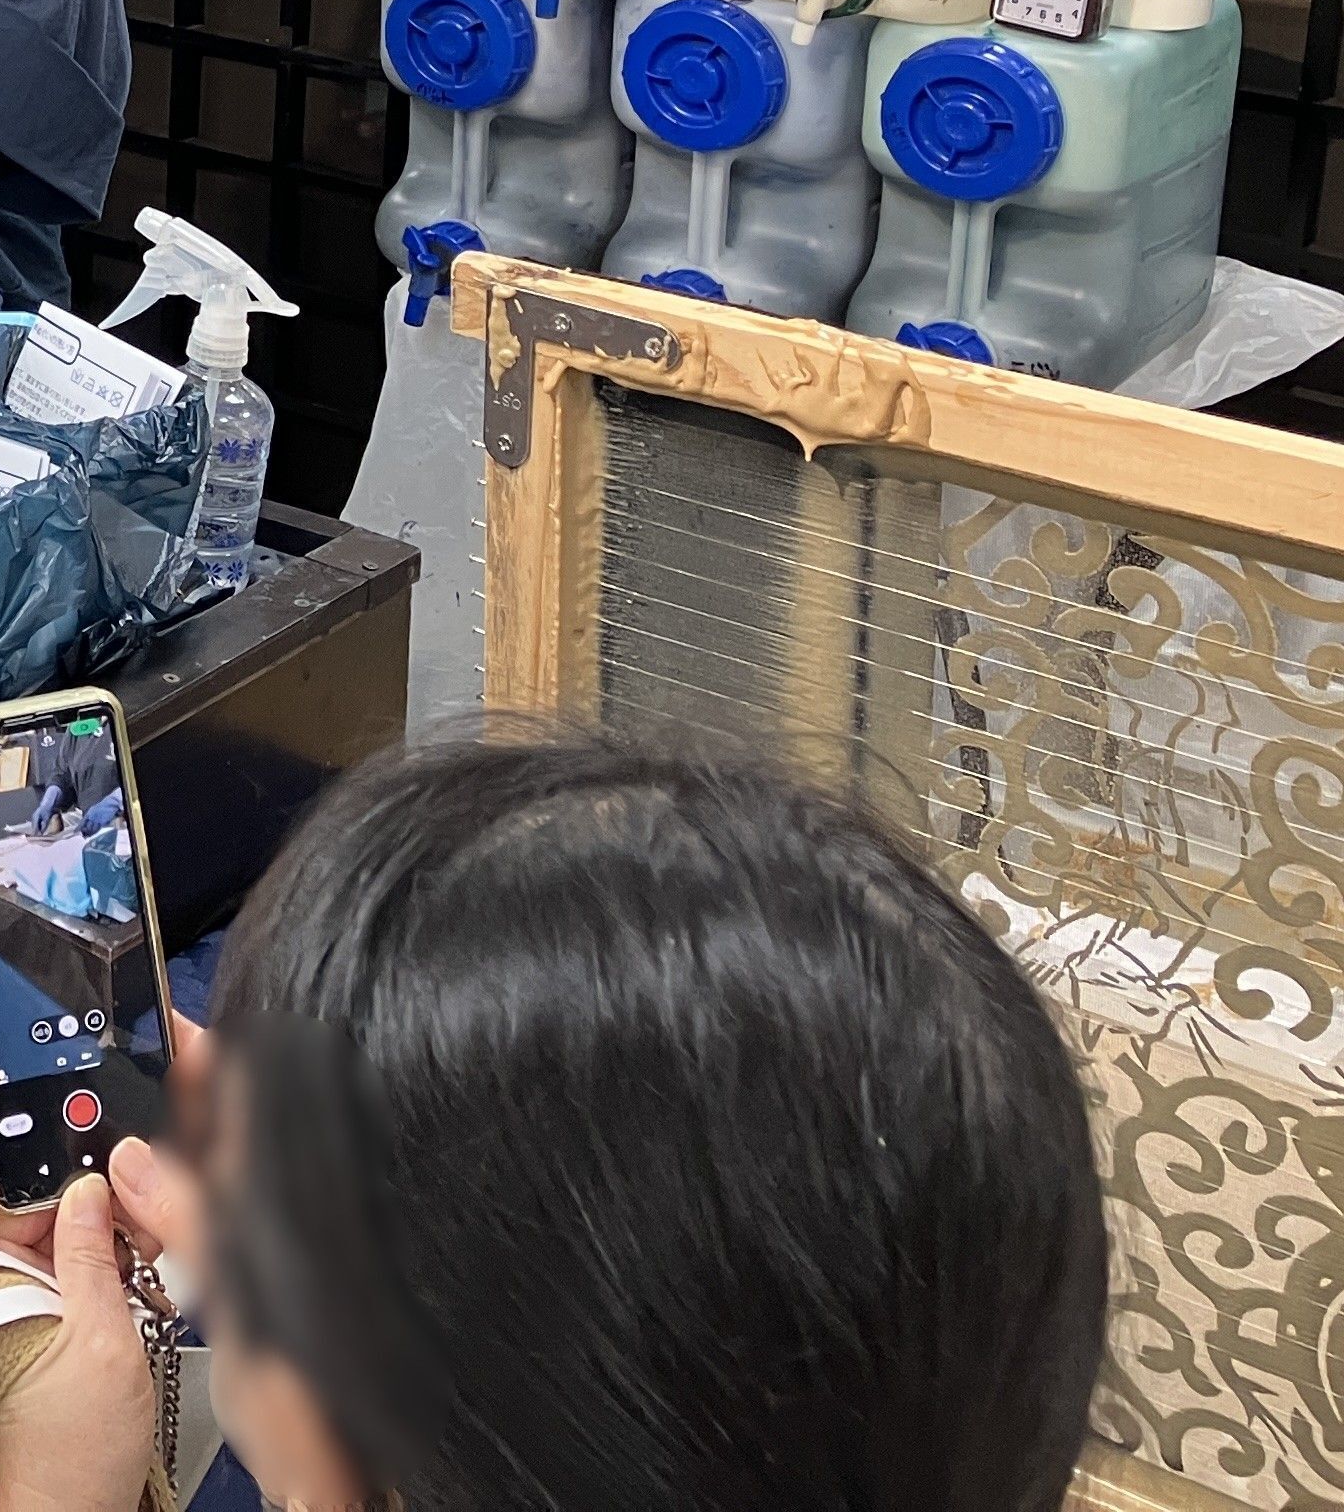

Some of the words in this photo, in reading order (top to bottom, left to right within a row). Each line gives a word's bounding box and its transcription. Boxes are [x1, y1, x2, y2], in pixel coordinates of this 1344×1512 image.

[1025, 7, 1032, 16] 7
[1039, 10, 1047, 20] 6
[1072, 9, 1078, 19] 4
[1055, 13, 1062, 23] 5
